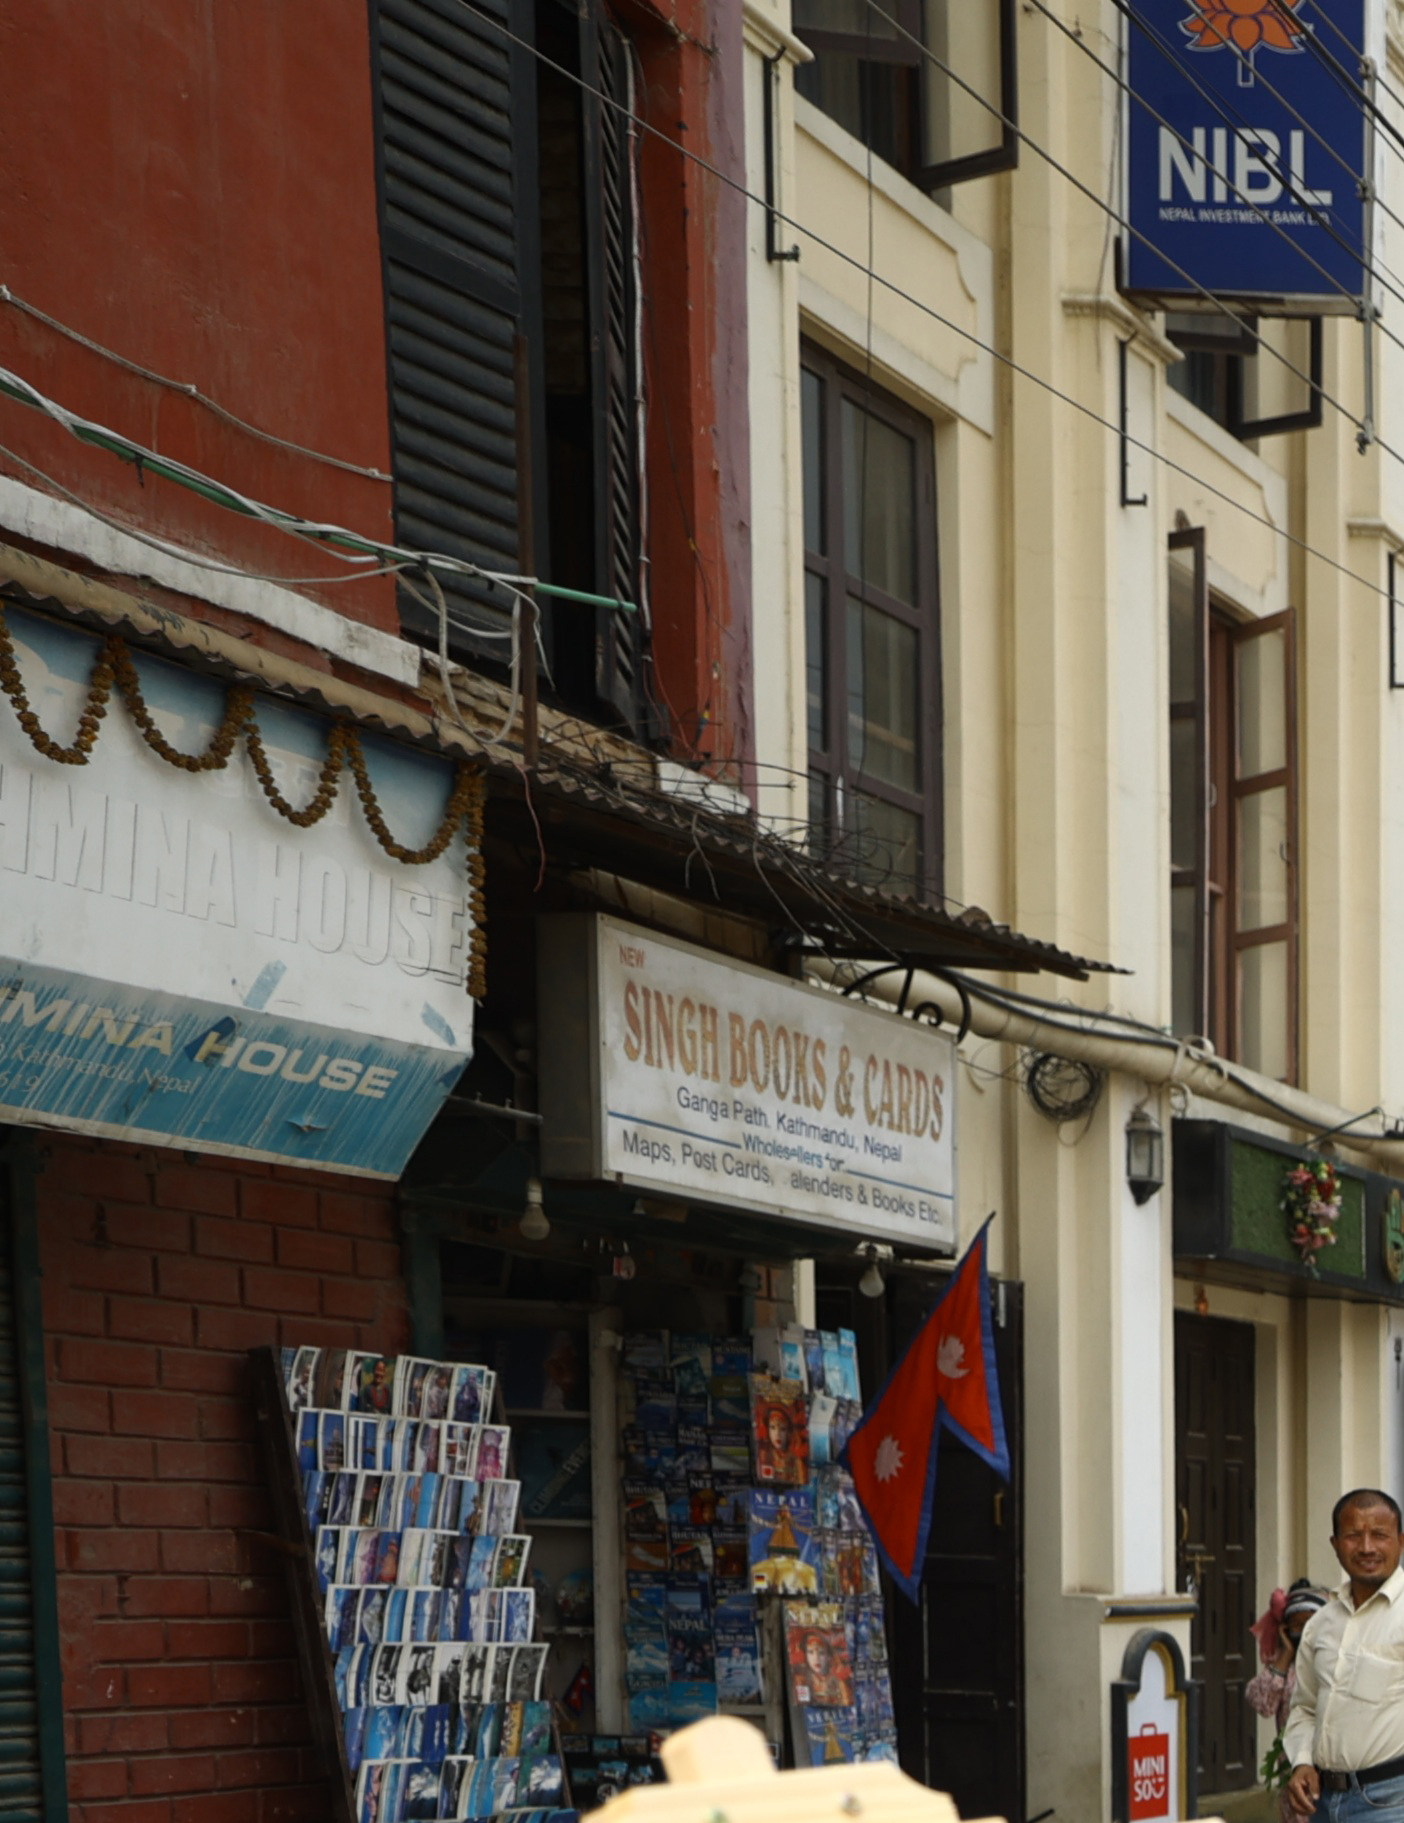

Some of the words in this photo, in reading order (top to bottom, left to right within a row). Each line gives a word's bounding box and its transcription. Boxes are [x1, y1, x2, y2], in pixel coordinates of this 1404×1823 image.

[1158, 125, 1333, 207] NIBL
[1158, 207, 1197, 222] NEPAL
[1200, 209, 1271, 225] INVESTMENT
[1273, 212, 1307, 225] BANK
[253, 843, 467, 987] HOUSE
[618, 945, 647, 969] NEW
[195, 1030, 398, 1099] HOUSE
[622, 980, 722, 1085] SINGH
[728, 1011, 828, 1113] BOOKS
[834, 1043, 856, 1120] &
[863, 1053, 945, 1144] CARDS
[676, 1085, 730, 1122] Ganga
[776, 1111, 859, 1154] Kathmandu,
[863, 1134, 903, 1164] Nepal
[622, 1128, 677, 1168] Maps,
[682, 1141, 718, 1174] Post
[722, 1152, 775, 1187] Cards,
[789, 1168, 854, 1203] alenders
[857, 1184, 869, 1206] &
[871, 1186, 917, 1219] Books
[918, 1200, 945, 1226] Etc.
[753, 1491, 810, 1509] NEPAL
[668, 1619, 710, 1632] NEPAL
[1133, 1754, 1165, 1779] MINI
